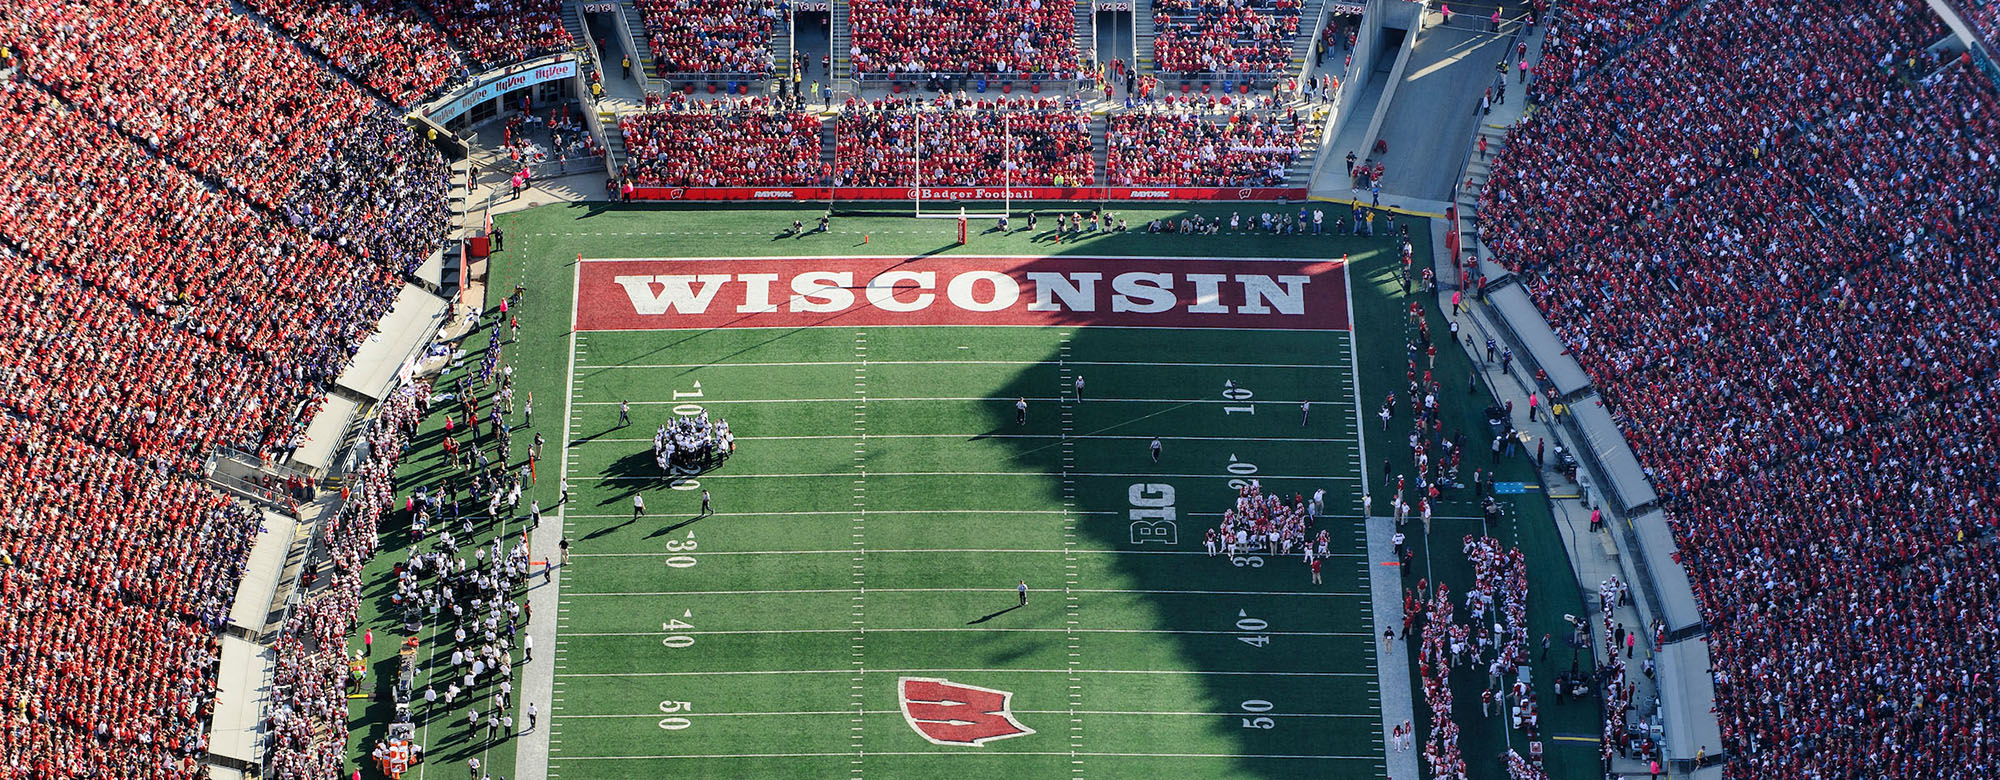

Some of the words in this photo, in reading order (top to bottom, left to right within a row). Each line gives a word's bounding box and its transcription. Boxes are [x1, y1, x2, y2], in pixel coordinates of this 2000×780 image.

[754, 190, 793, 198] RAYOVAC
[1130, 190, 1170, 198] RAYOVAC
[614, 271, 1311, 315] WISCONSIN
[673, 388, 704, 416] 10
[1222, 388, 1255, 416] 10
[665, 539, 698, 568] 30
[662, 618, 696, 648] 40
[1235, 618, 1270, 648] 40
[658, 700, 692, 730] 50
[1240, 699, 1275, 730] 50
